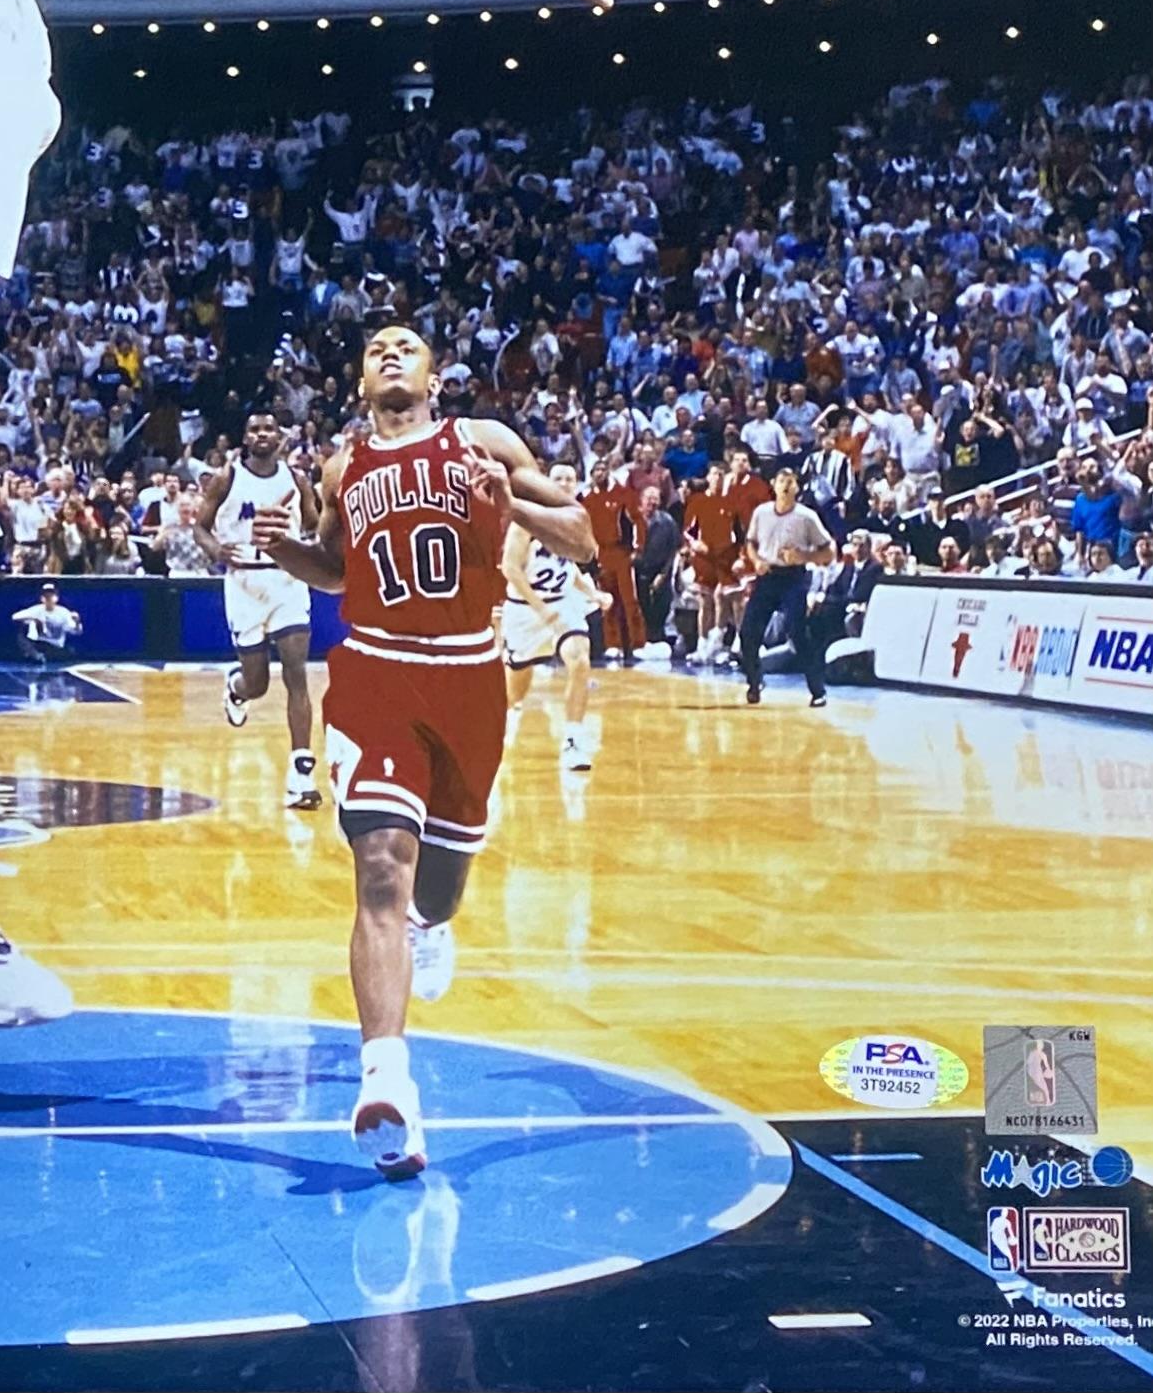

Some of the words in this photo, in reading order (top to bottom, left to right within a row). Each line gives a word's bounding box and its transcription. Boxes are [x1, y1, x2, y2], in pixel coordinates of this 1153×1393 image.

[344, 459, 471, 548] BULLS
[368, 523, 460, 607] 10
[1089, 629, 1153, 675] NBA
[1069, 1031, 1090, 1041] KGW
[852, 1065, 864, 1074] IN
[866, 1066, 884, 1076] THE
[886, 1068, 935, 1080] PRESENCE
[860, 1078, 921, 1094] 3T92452
